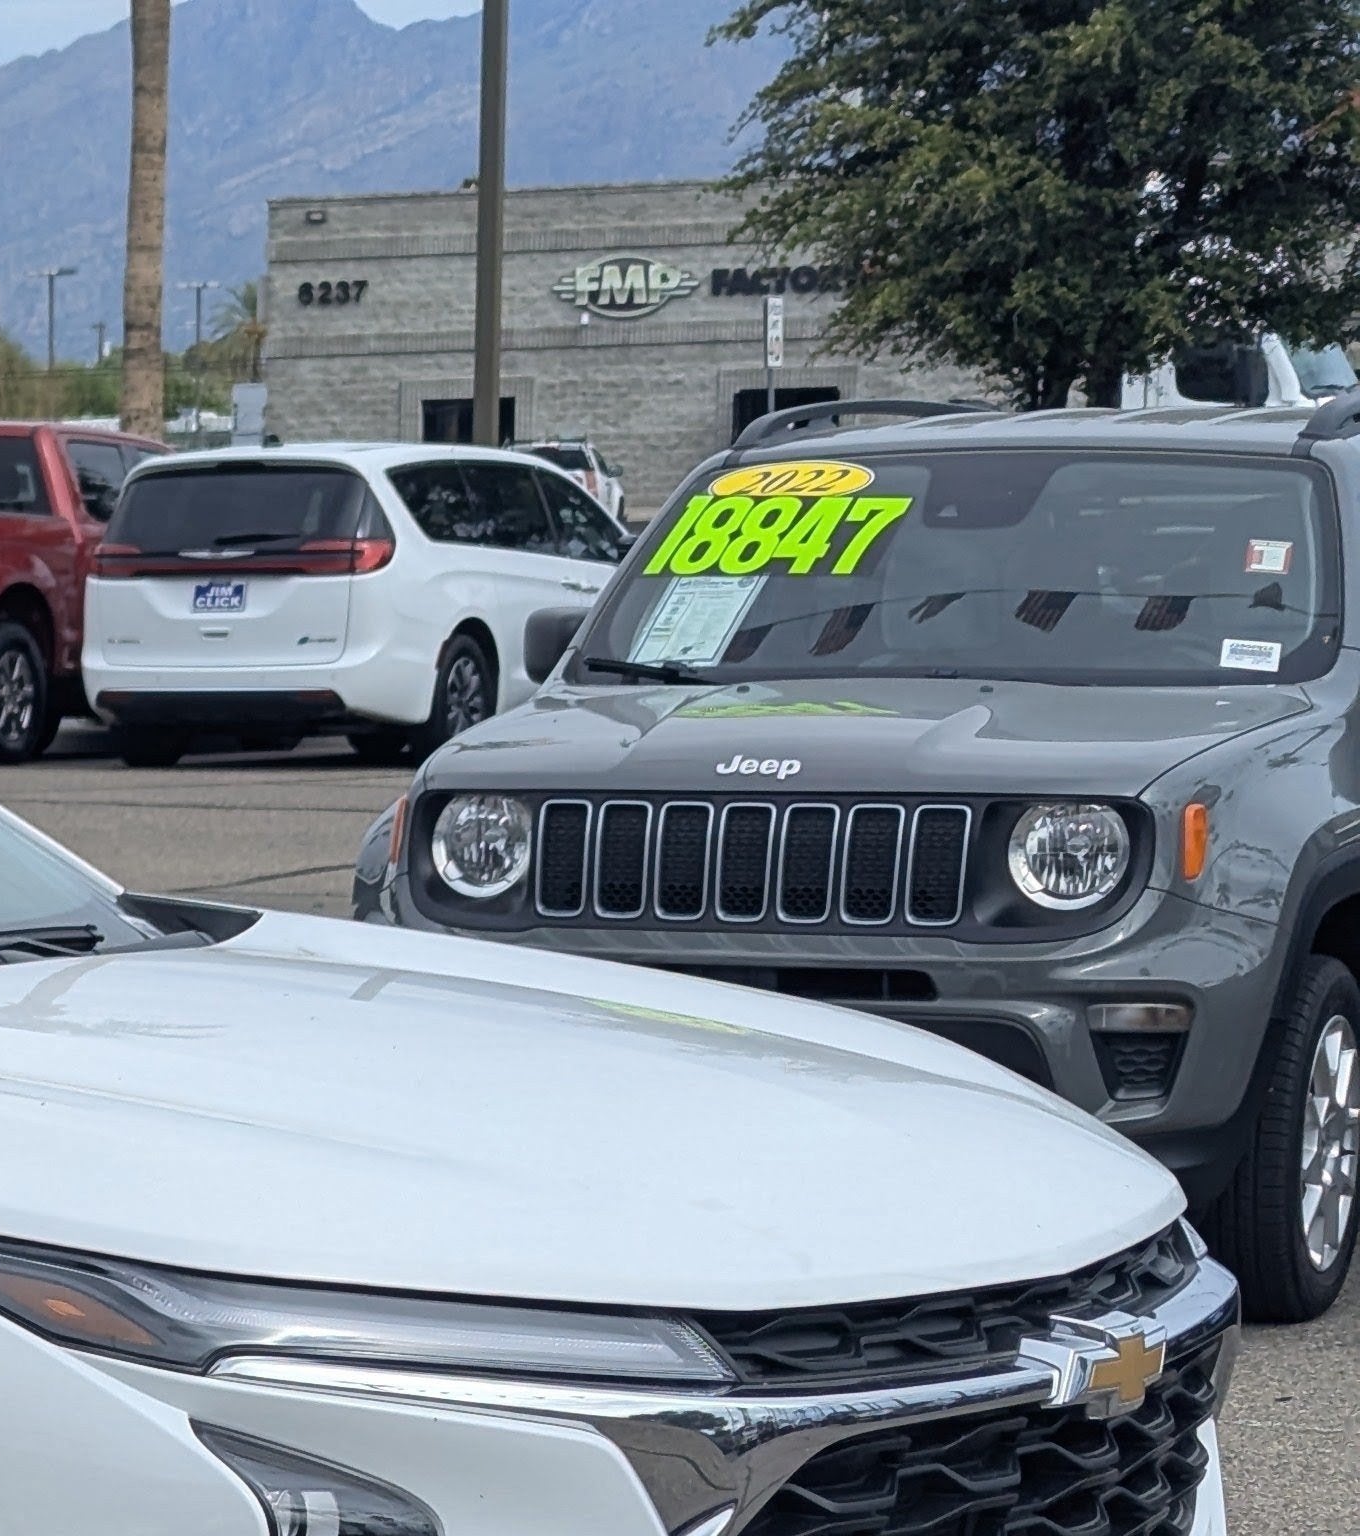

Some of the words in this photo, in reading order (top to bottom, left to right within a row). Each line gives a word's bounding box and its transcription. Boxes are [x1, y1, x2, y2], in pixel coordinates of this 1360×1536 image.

[298, 280, 368, 306] 6237
[574, 263, 682, 306] FMP
[710, 264, 872, 296] FACTOR
[733, 469, 851, 494] 2022
[642, 494, 914, 575] 18847
[195, 596, 241, 608] CLICK
[206, 586, 234, 597] JIM
[715, 754, 802, 780] Jeep
